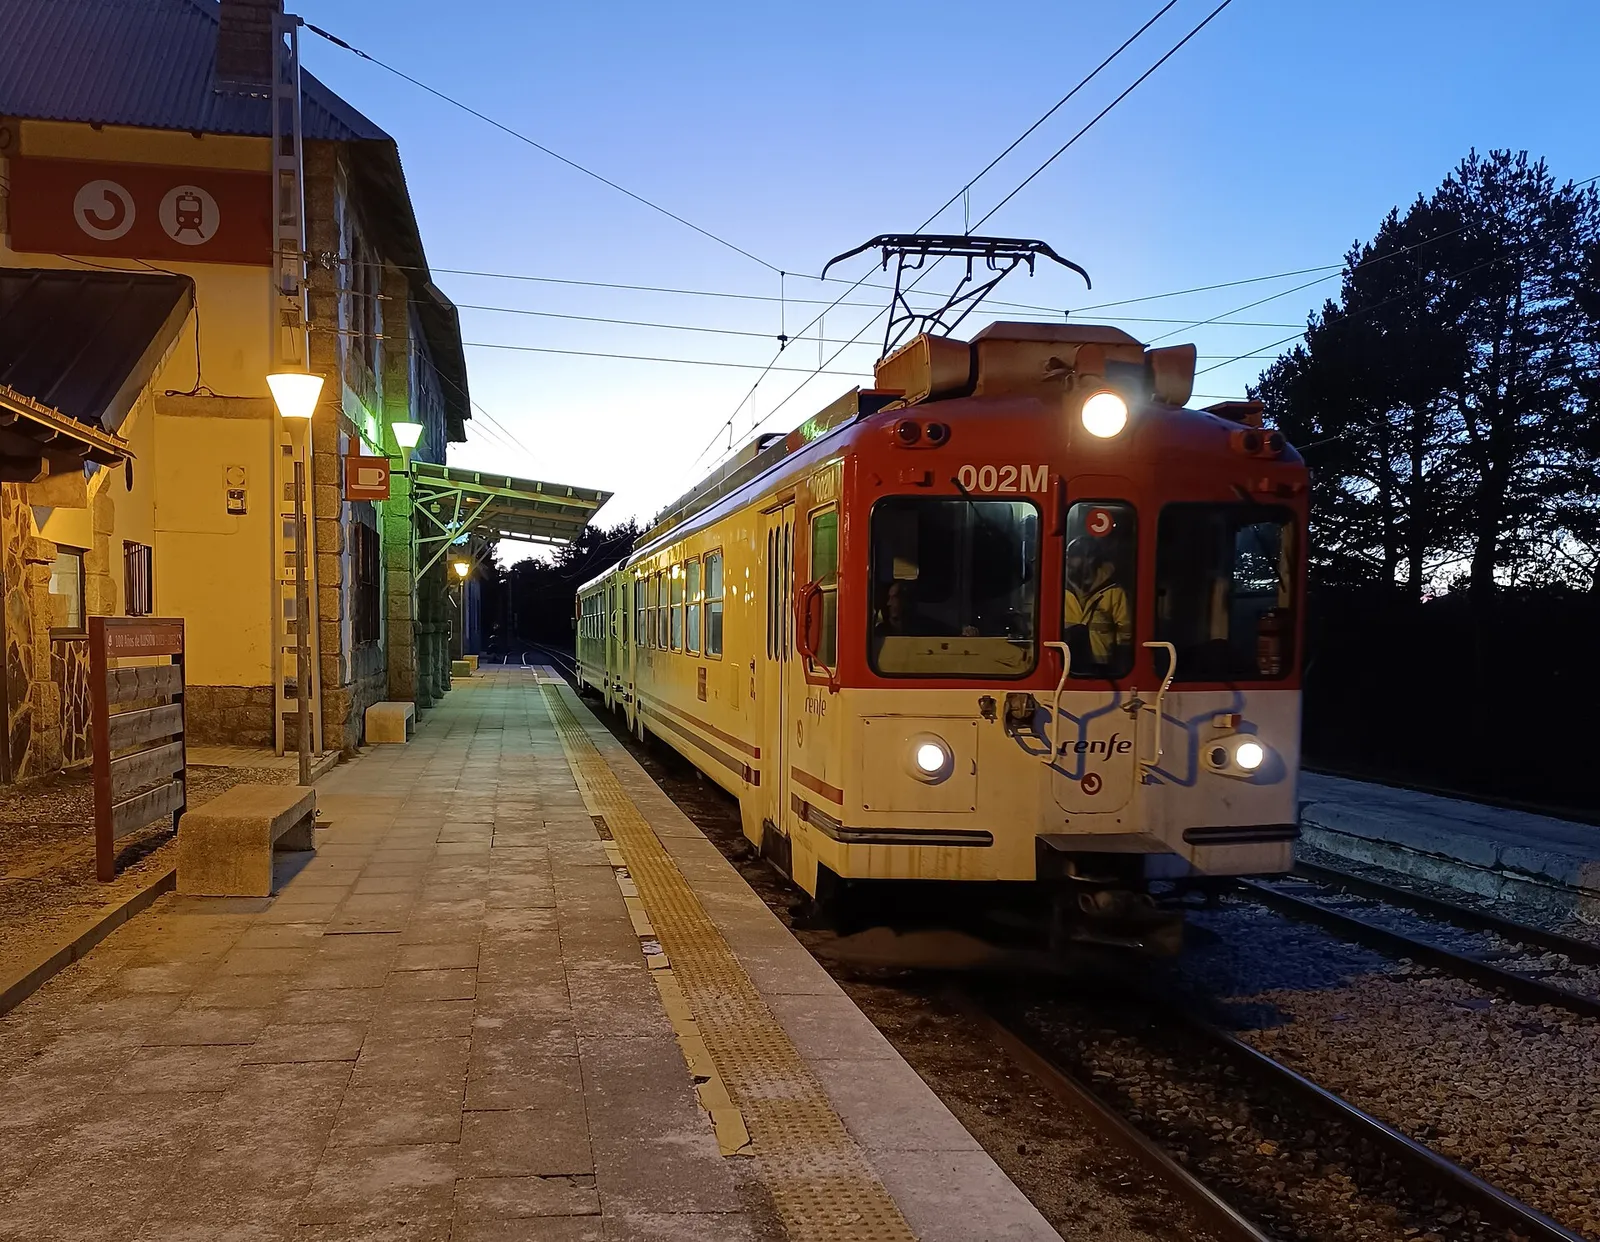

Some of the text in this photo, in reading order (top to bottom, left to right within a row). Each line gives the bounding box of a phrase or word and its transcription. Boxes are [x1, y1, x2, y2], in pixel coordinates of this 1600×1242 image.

[957, 464, 1049, 493] 002M
[805, 688, 827, 727] renfe
[1060, 732, 1132, 762] renfe
